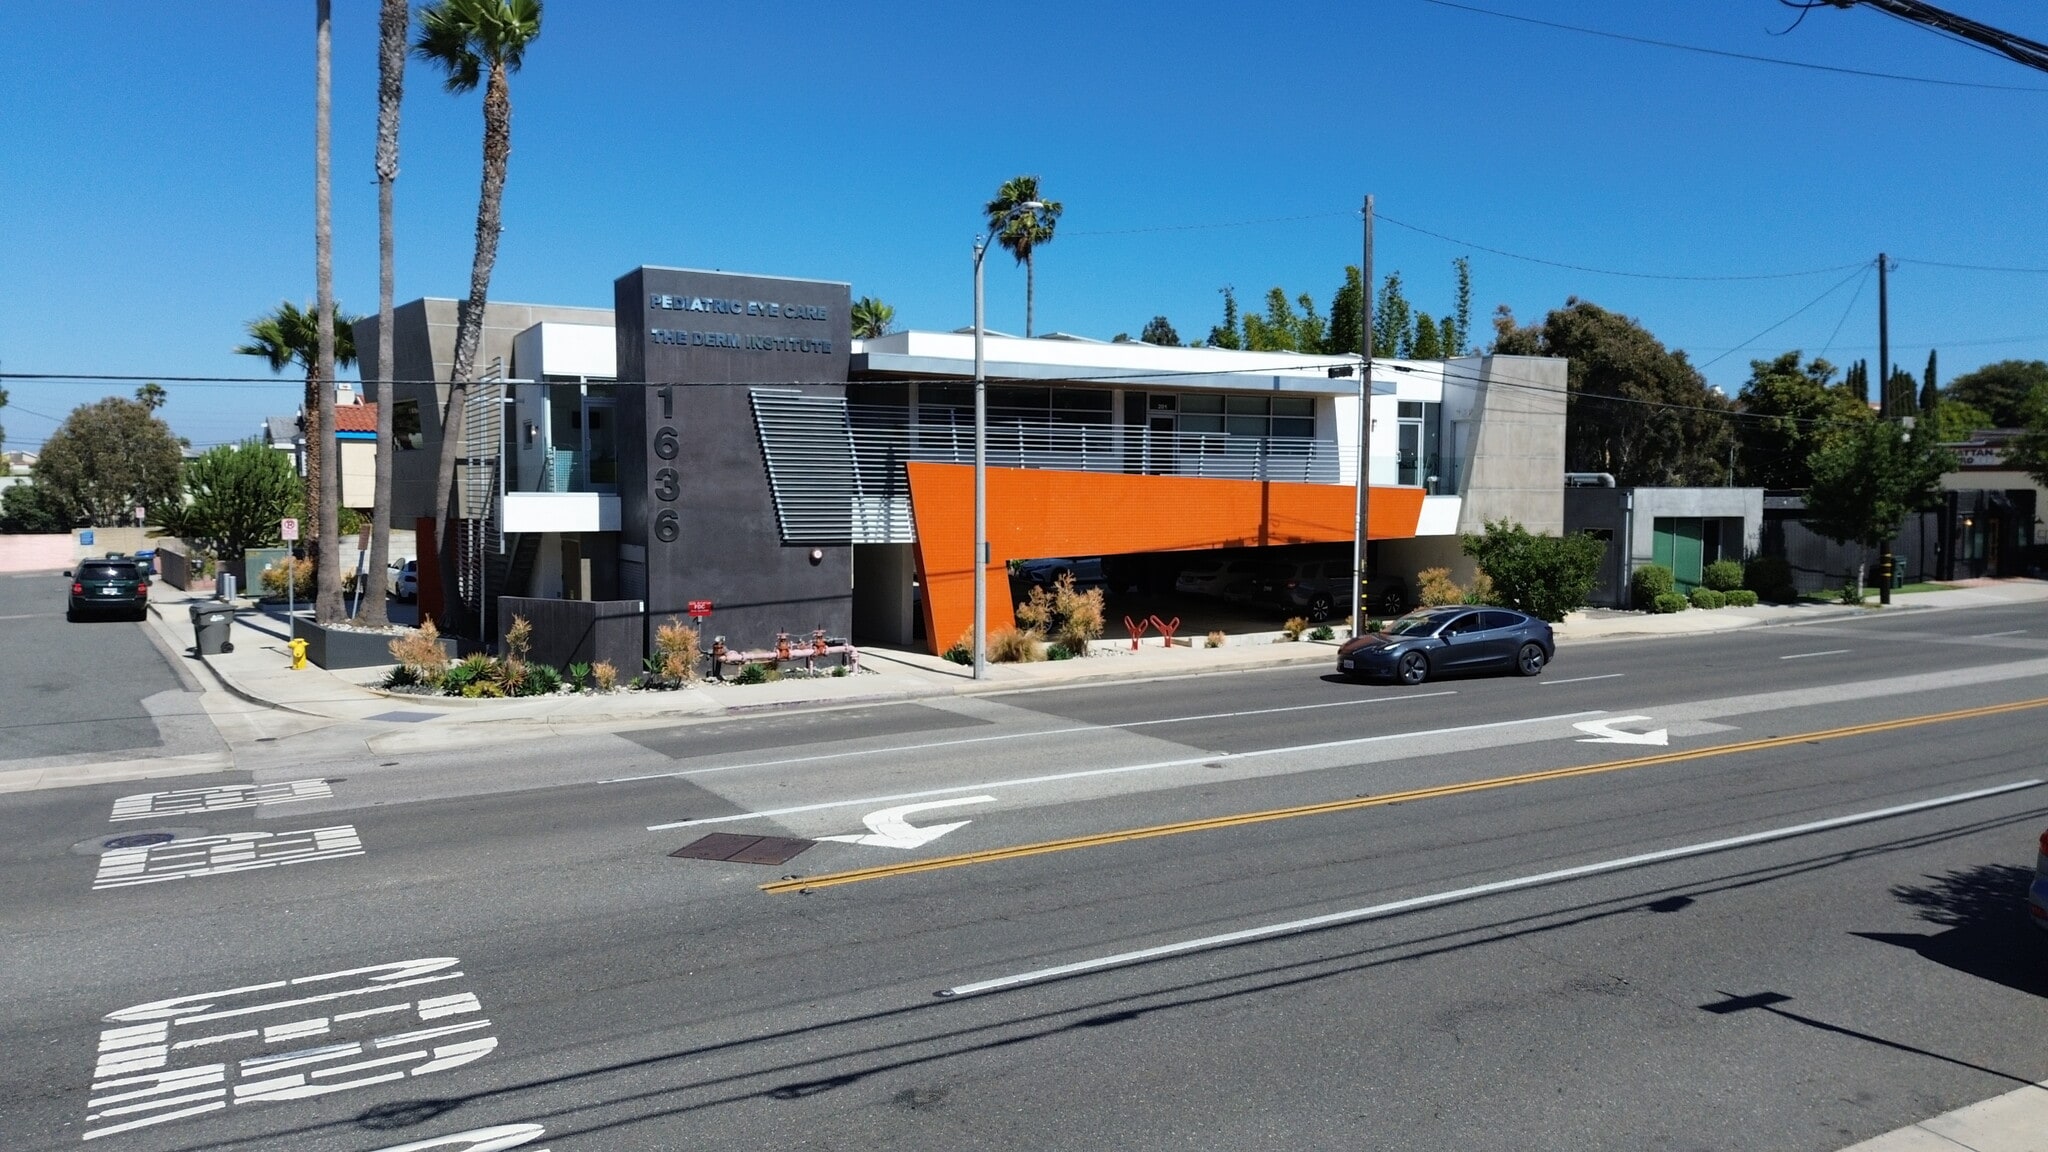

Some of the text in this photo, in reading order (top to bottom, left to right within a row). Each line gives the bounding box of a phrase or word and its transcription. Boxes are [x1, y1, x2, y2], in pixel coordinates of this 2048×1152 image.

[650, 293, 827, 321] PEDIATRIC EYE CARE
[651, 328, 832, 354] THE DERM INSTITUTE
[653, 385, 681, 543] 1636
[82, 956, 498, 1140] CLEAR
